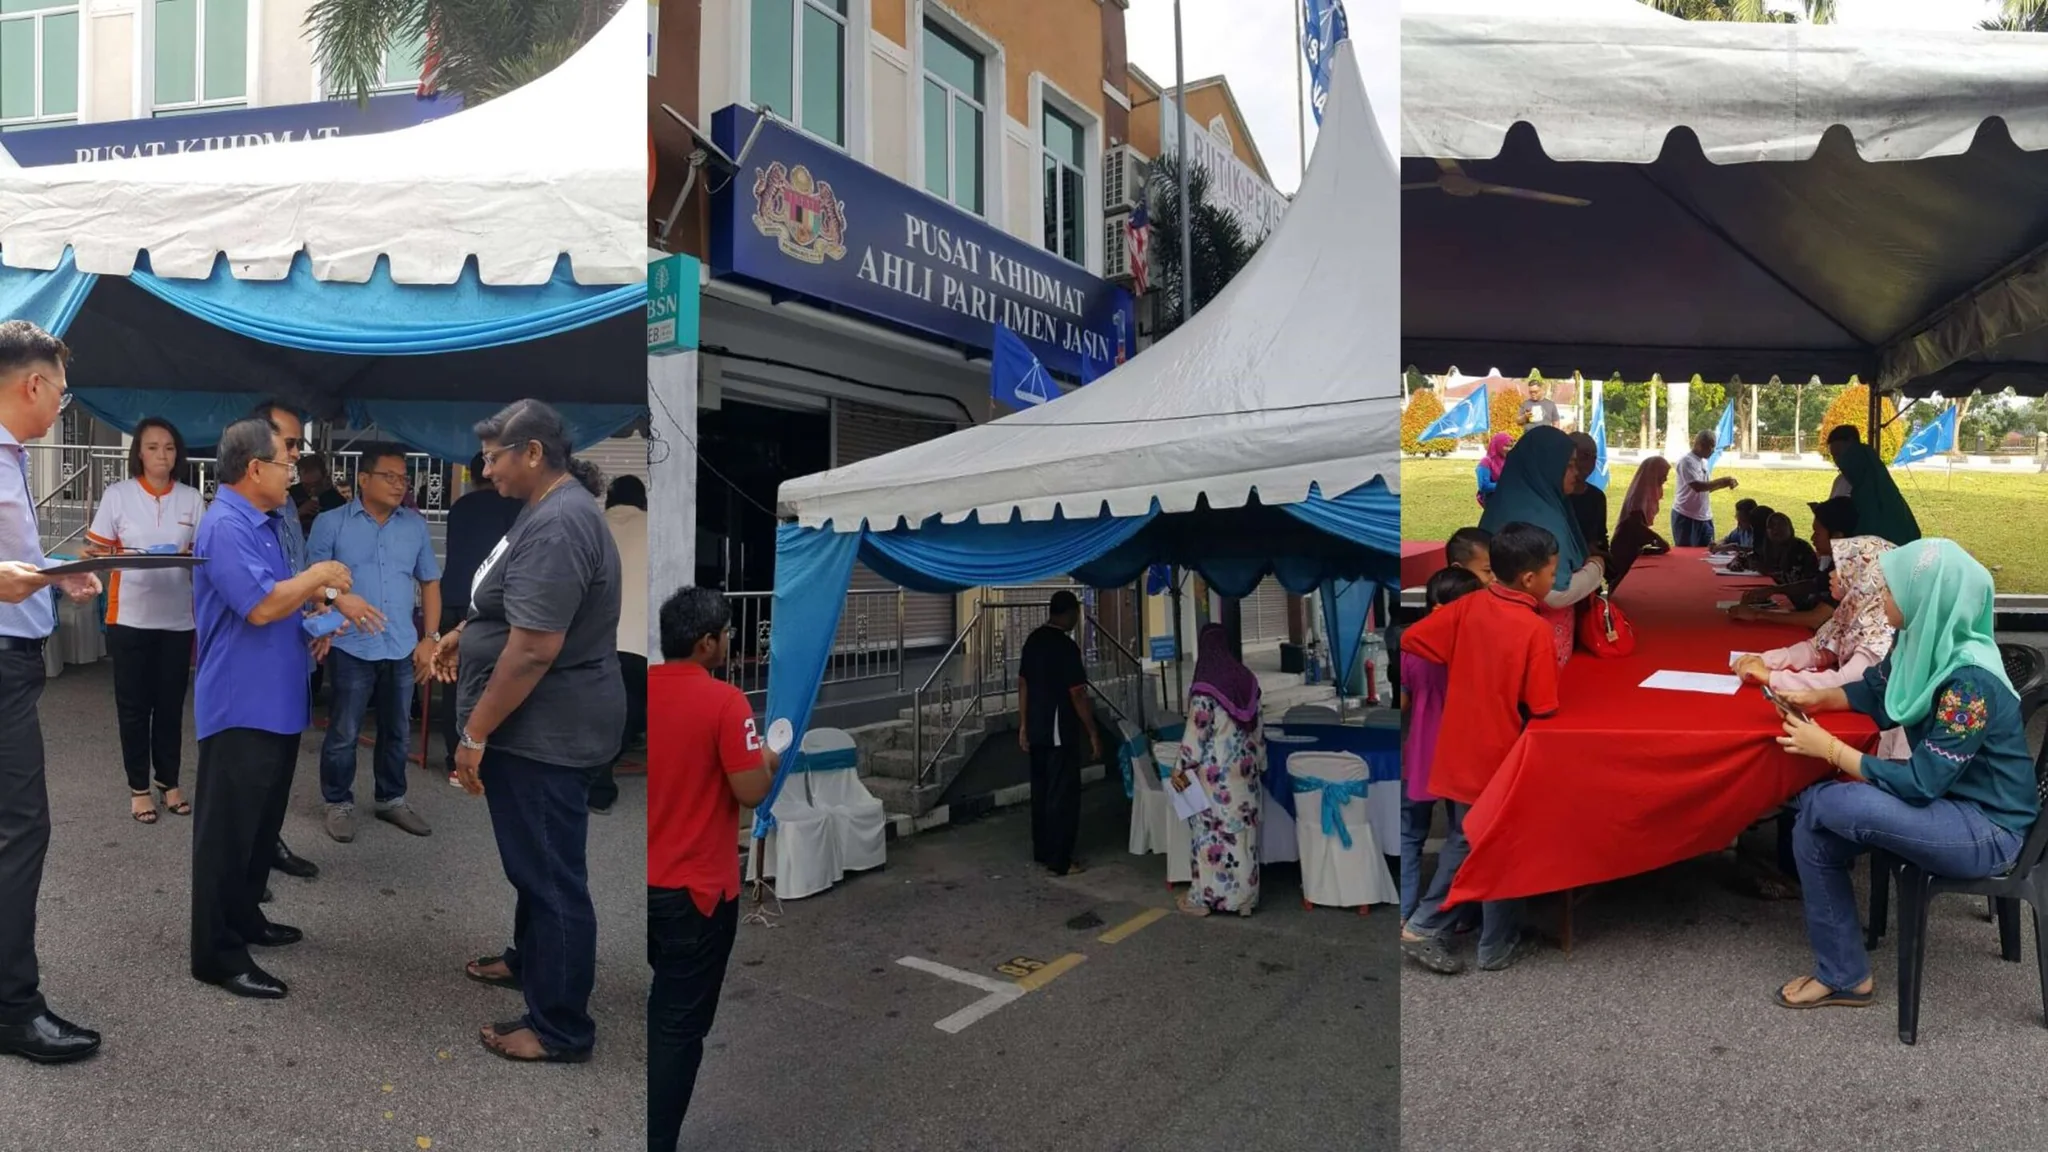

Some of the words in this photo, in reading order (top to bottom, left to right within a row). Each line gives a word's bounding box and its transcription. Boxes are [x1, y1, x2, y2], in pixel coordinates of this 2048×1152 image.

[648, 293, 677, 319] BSN
[857, 245, 933, 302] AHLI
[941, 274, 1057, 345] PARLIMEN
[1062, 321, 1109, 362] JASIN
[904, 213, 981, 274] PUSAT
[988, 250, 1085, 317] KHIDMAT
